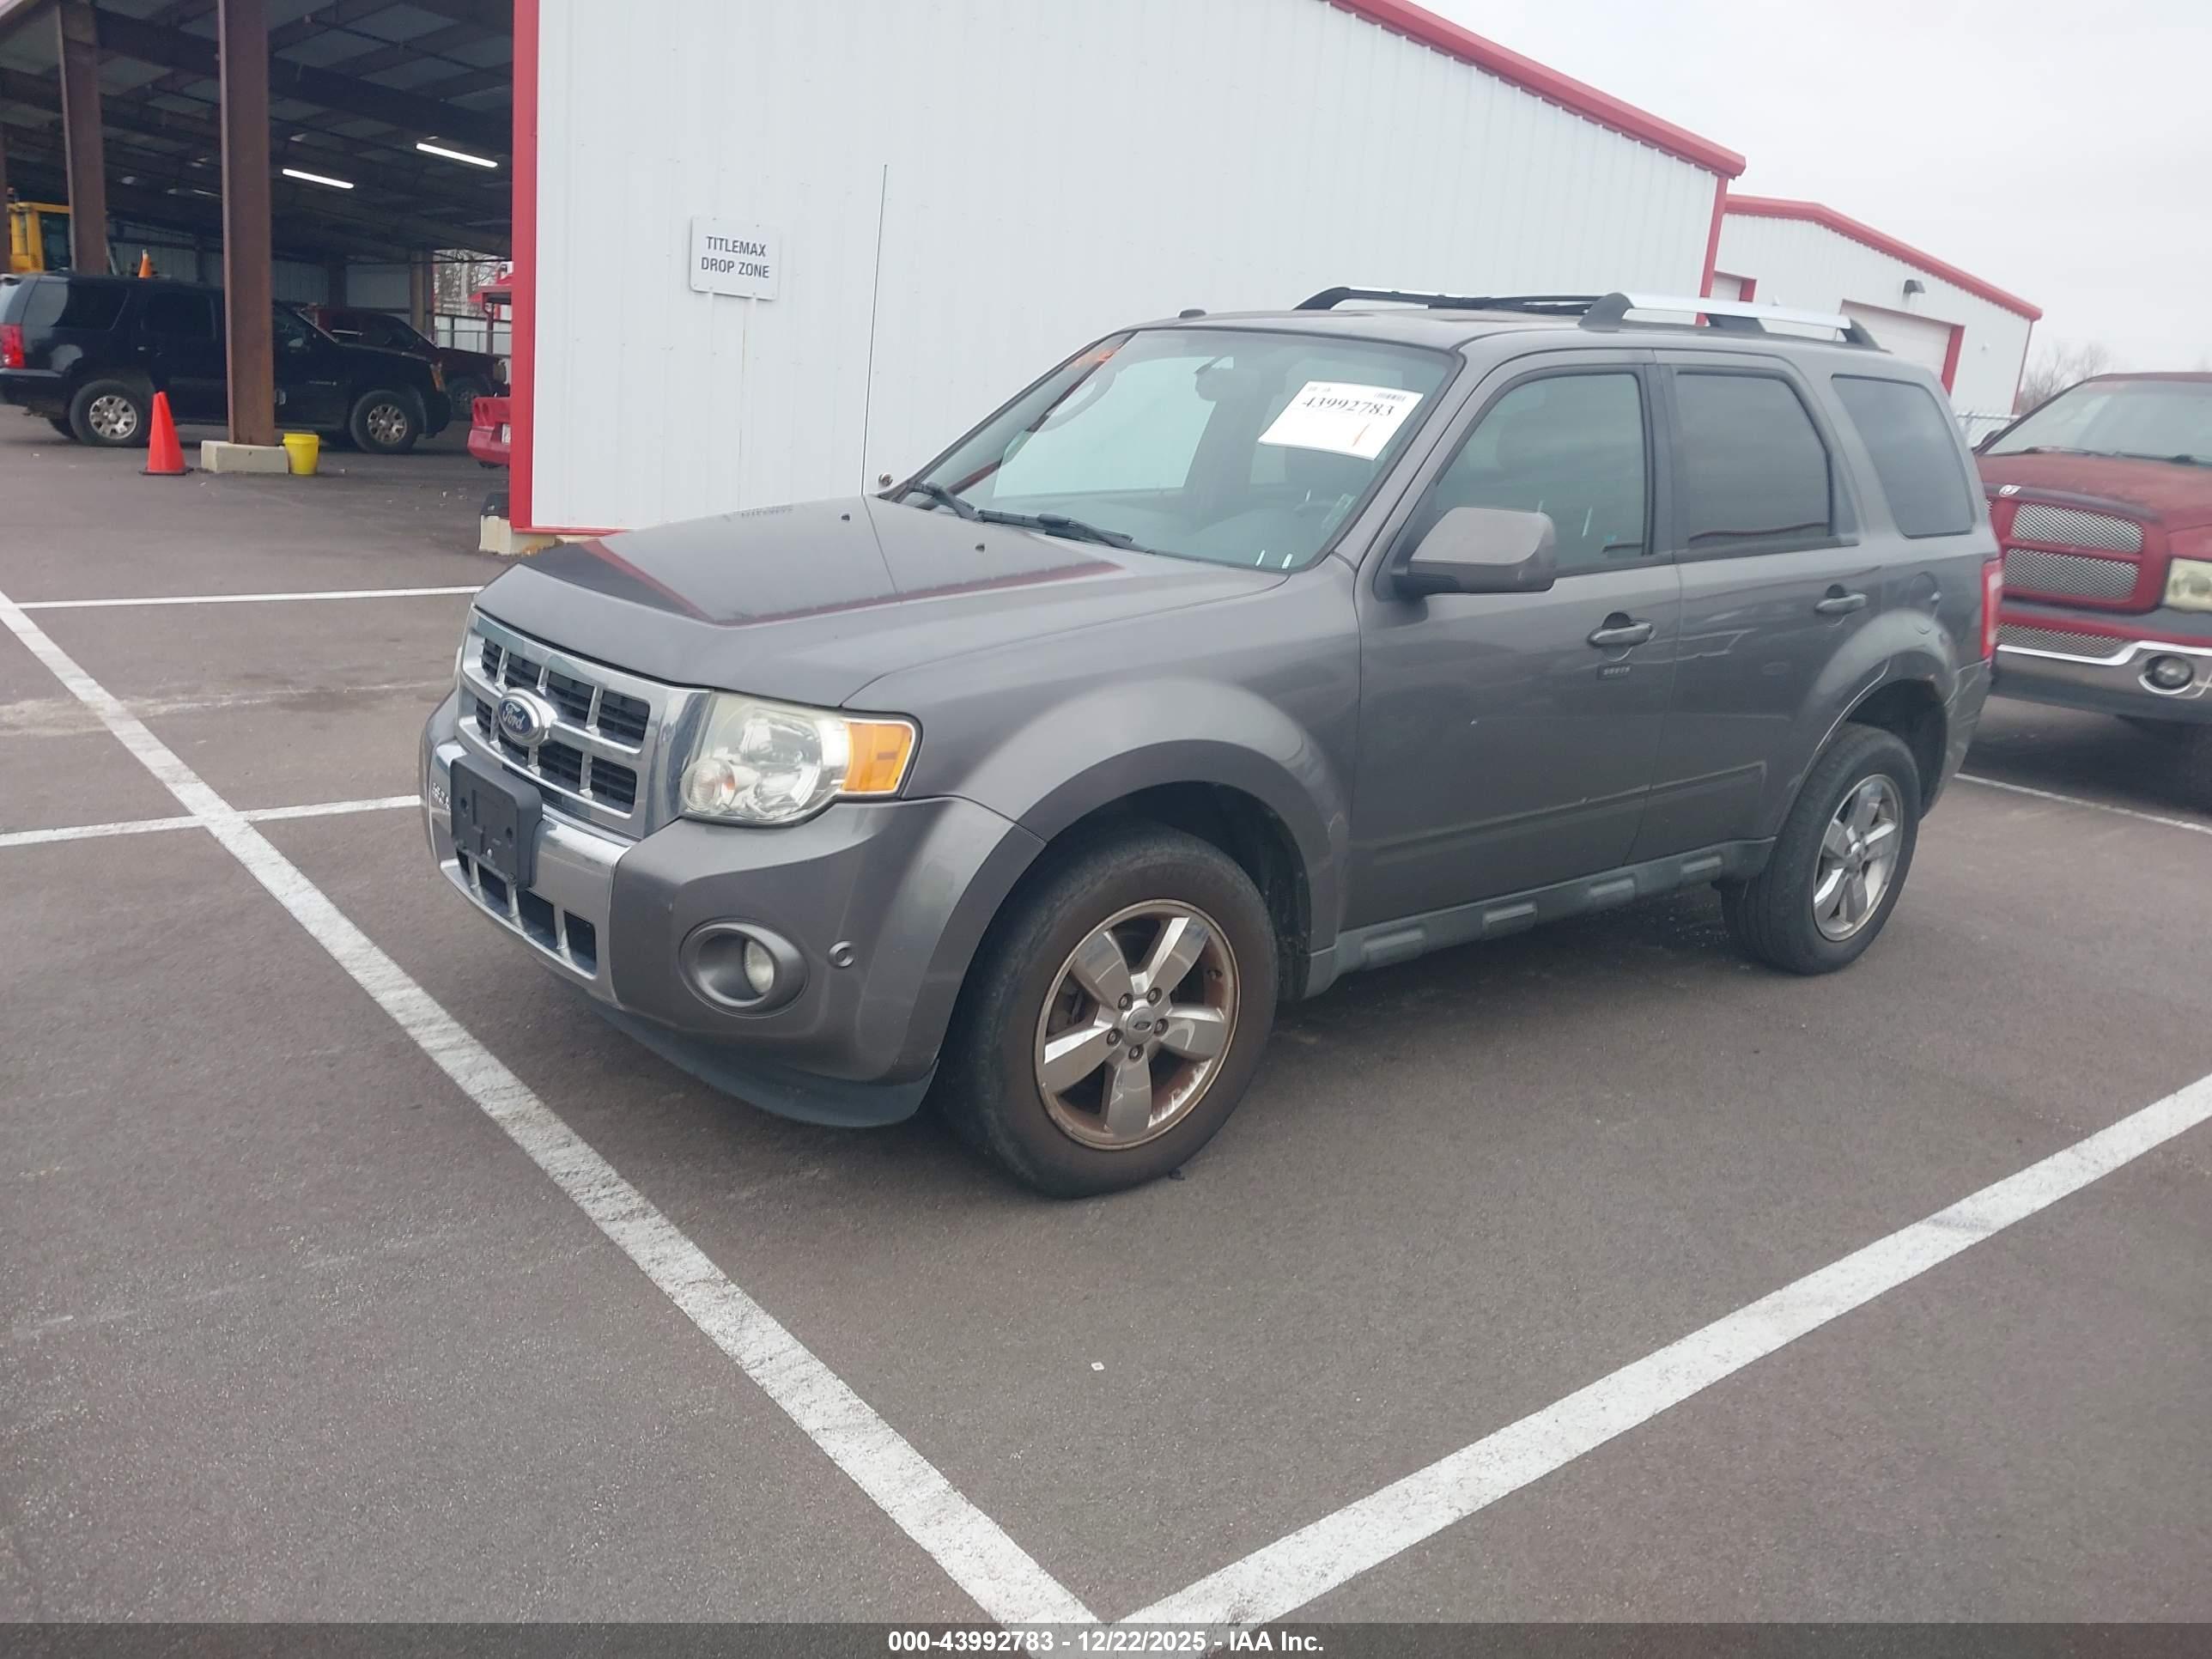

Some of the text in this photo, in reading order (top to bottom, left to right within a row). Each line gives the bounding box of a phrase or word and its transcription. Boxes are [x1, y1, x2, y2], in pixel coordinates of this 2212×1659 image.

[706, 235, 767, 258] TITLEMAX
[701, 257, 770, 278] DROP ZONE
[1303, 396, 1395, 416] 43992783
[502, 702, 526, 730] Ford
